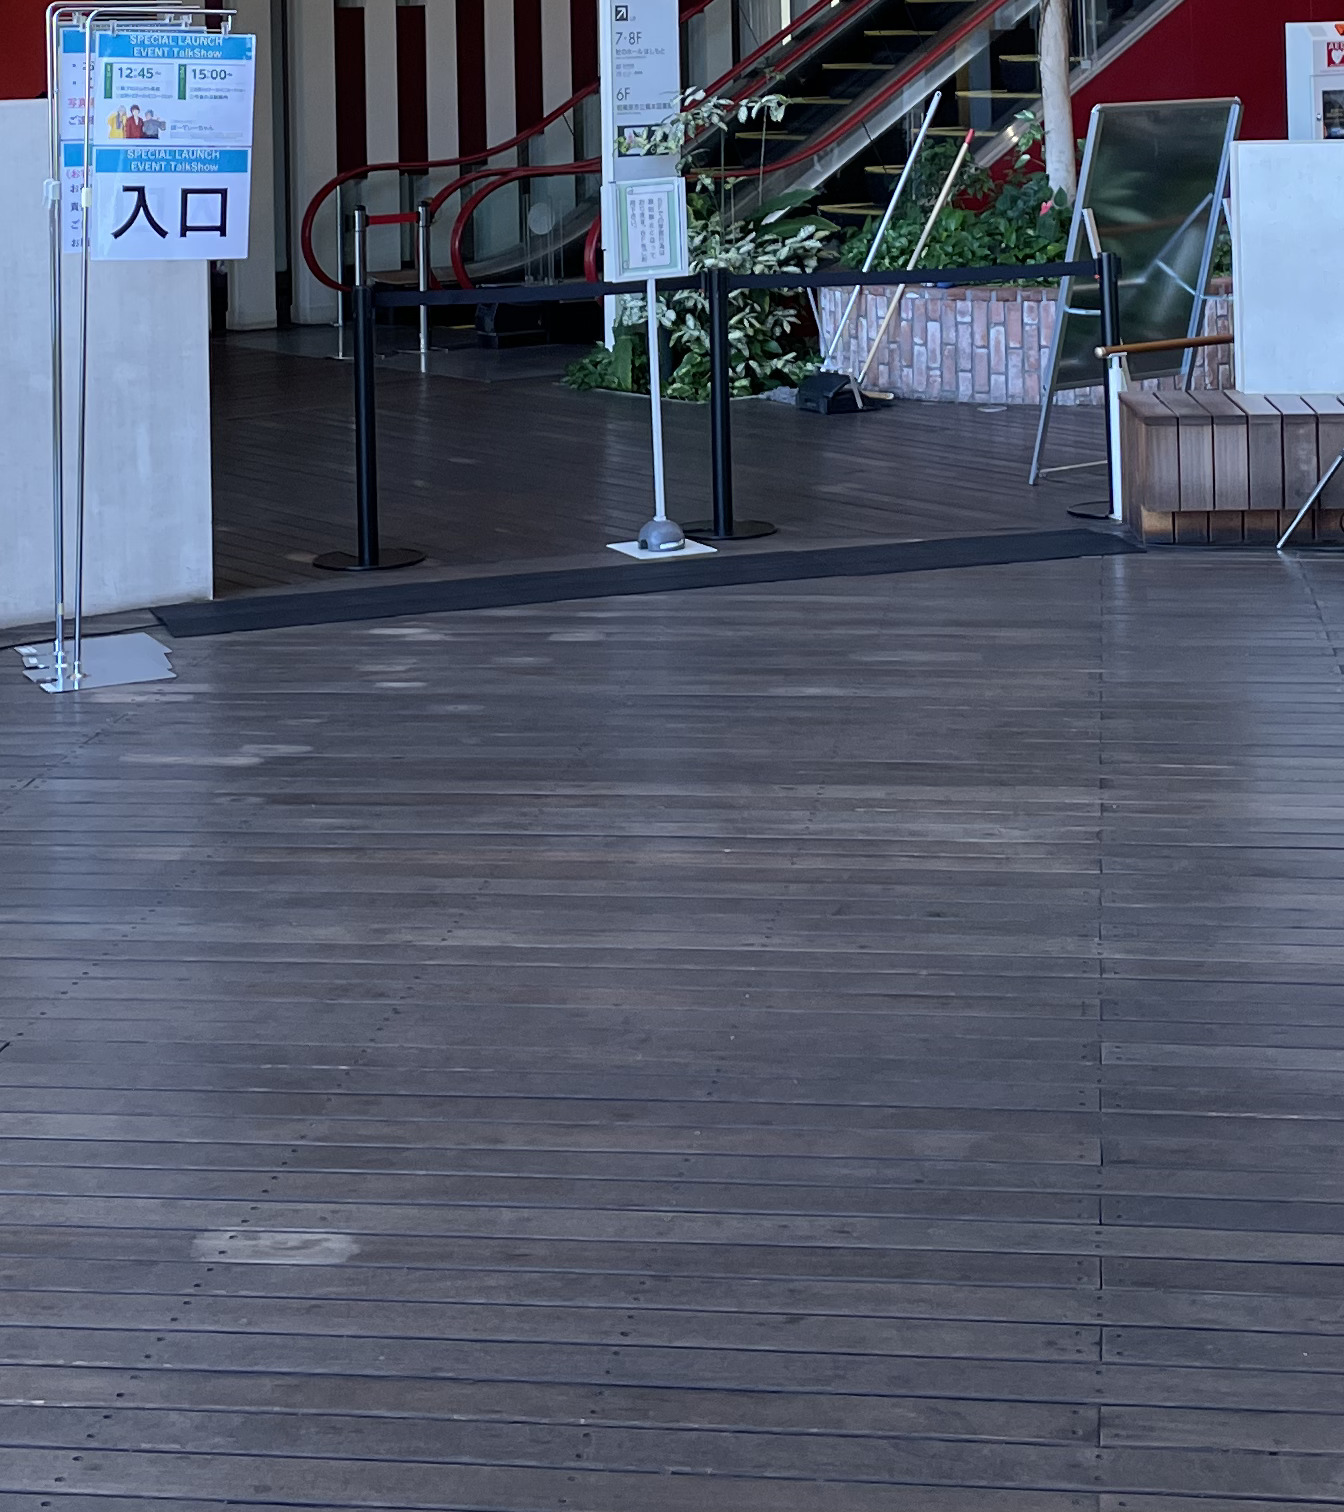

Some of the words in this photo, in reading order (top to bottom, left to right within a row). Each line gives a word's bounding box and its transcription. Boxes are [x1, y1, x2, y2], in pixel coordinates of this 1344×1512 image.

[130, 34, 176, 45] SPECIAL
[177, 35, 223, 46] LAUNCH
[133, 46, 169, 57] EVENT
[172, 47, 222, 58] TalkShow
[616, 87, 631, 101] 6F
[127, 149, 172, 159] SPECIAL
[175, 149, 220, 160] LAUNCH
[130, 161, 167, 172] EVENT
[170, 162, 218, 172] TalkShow
[111, 185, 228, 239] 入口
